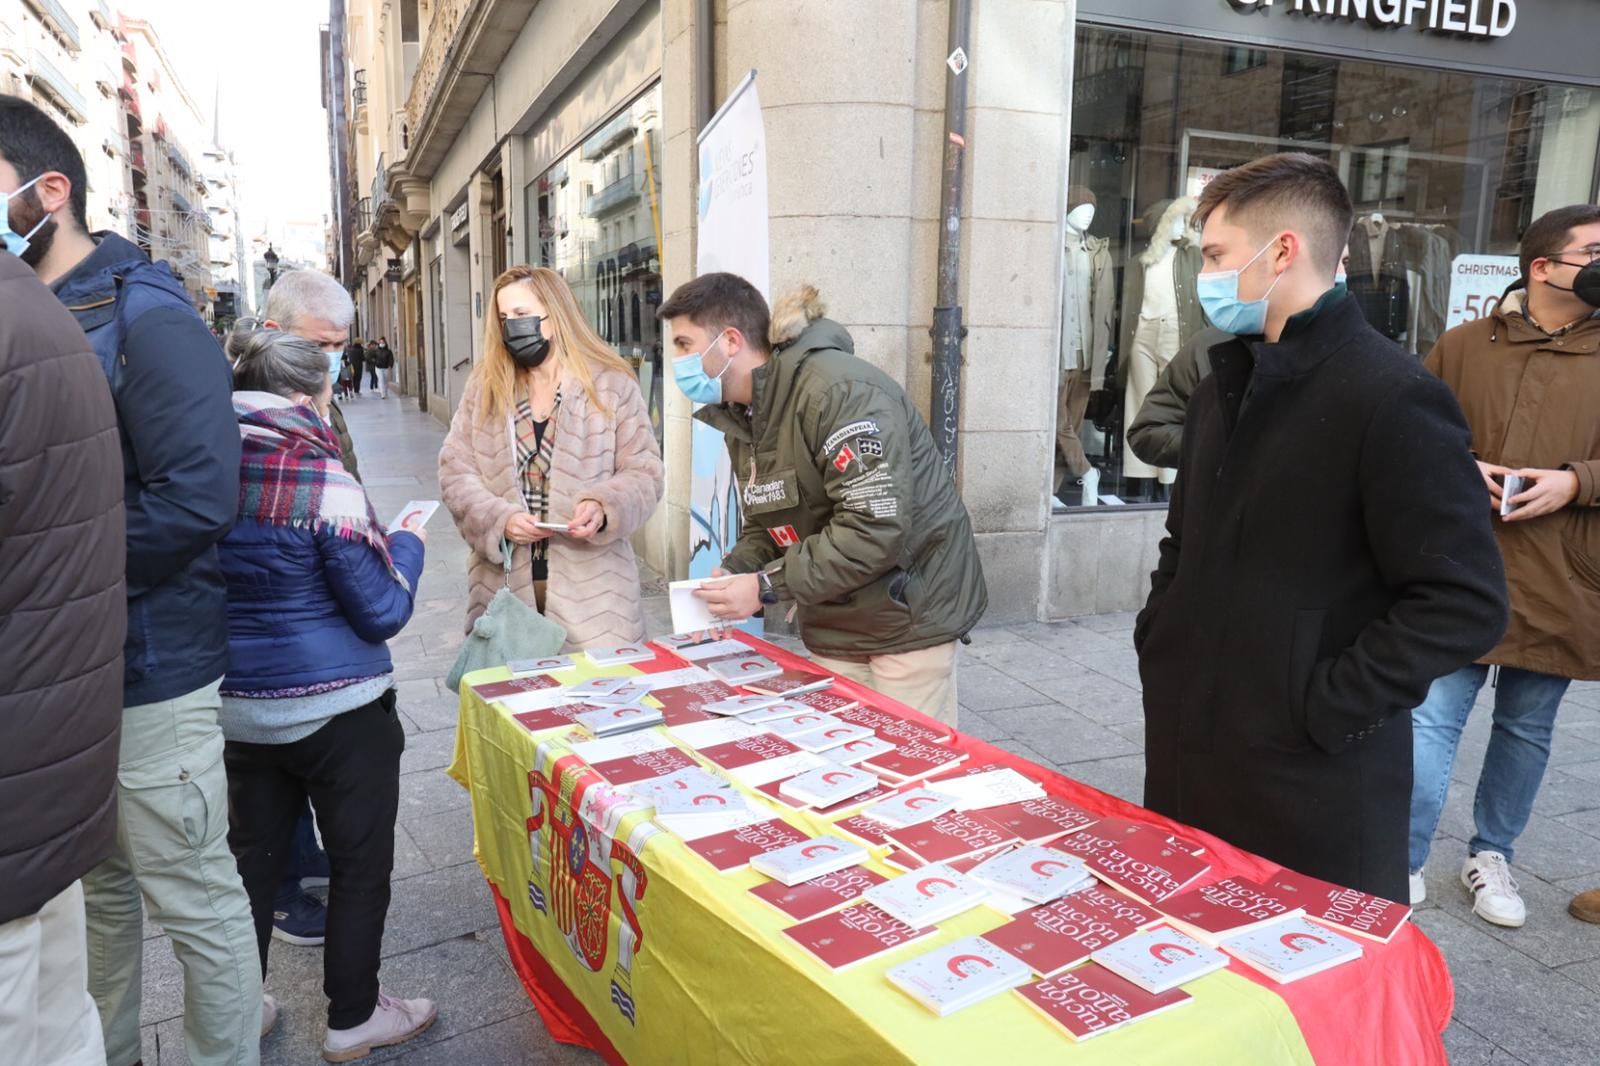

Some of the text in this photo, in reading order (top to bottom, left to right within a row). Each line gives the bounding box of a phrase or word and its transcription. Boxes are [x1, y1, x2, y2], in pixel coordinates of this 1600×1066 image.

[1233, 0, 1517, 37] GFIELD
[1457, 263, 1519, 277] CHRISTMAS
[1096, 856, 1169, 899] tución
[1108, 849, 1180, 890] añola
[1199, 885, 1270, 920] añola
[1217, 879, 1288, 913] tución
[839, 907, 901, 947] añola
[1030, 908, 1103, 950] añola
[1049, 900, 1121, 941] tución
[1035, 980, 1107, 1031] tución
[1057, 973, 1133, 1022] añola
